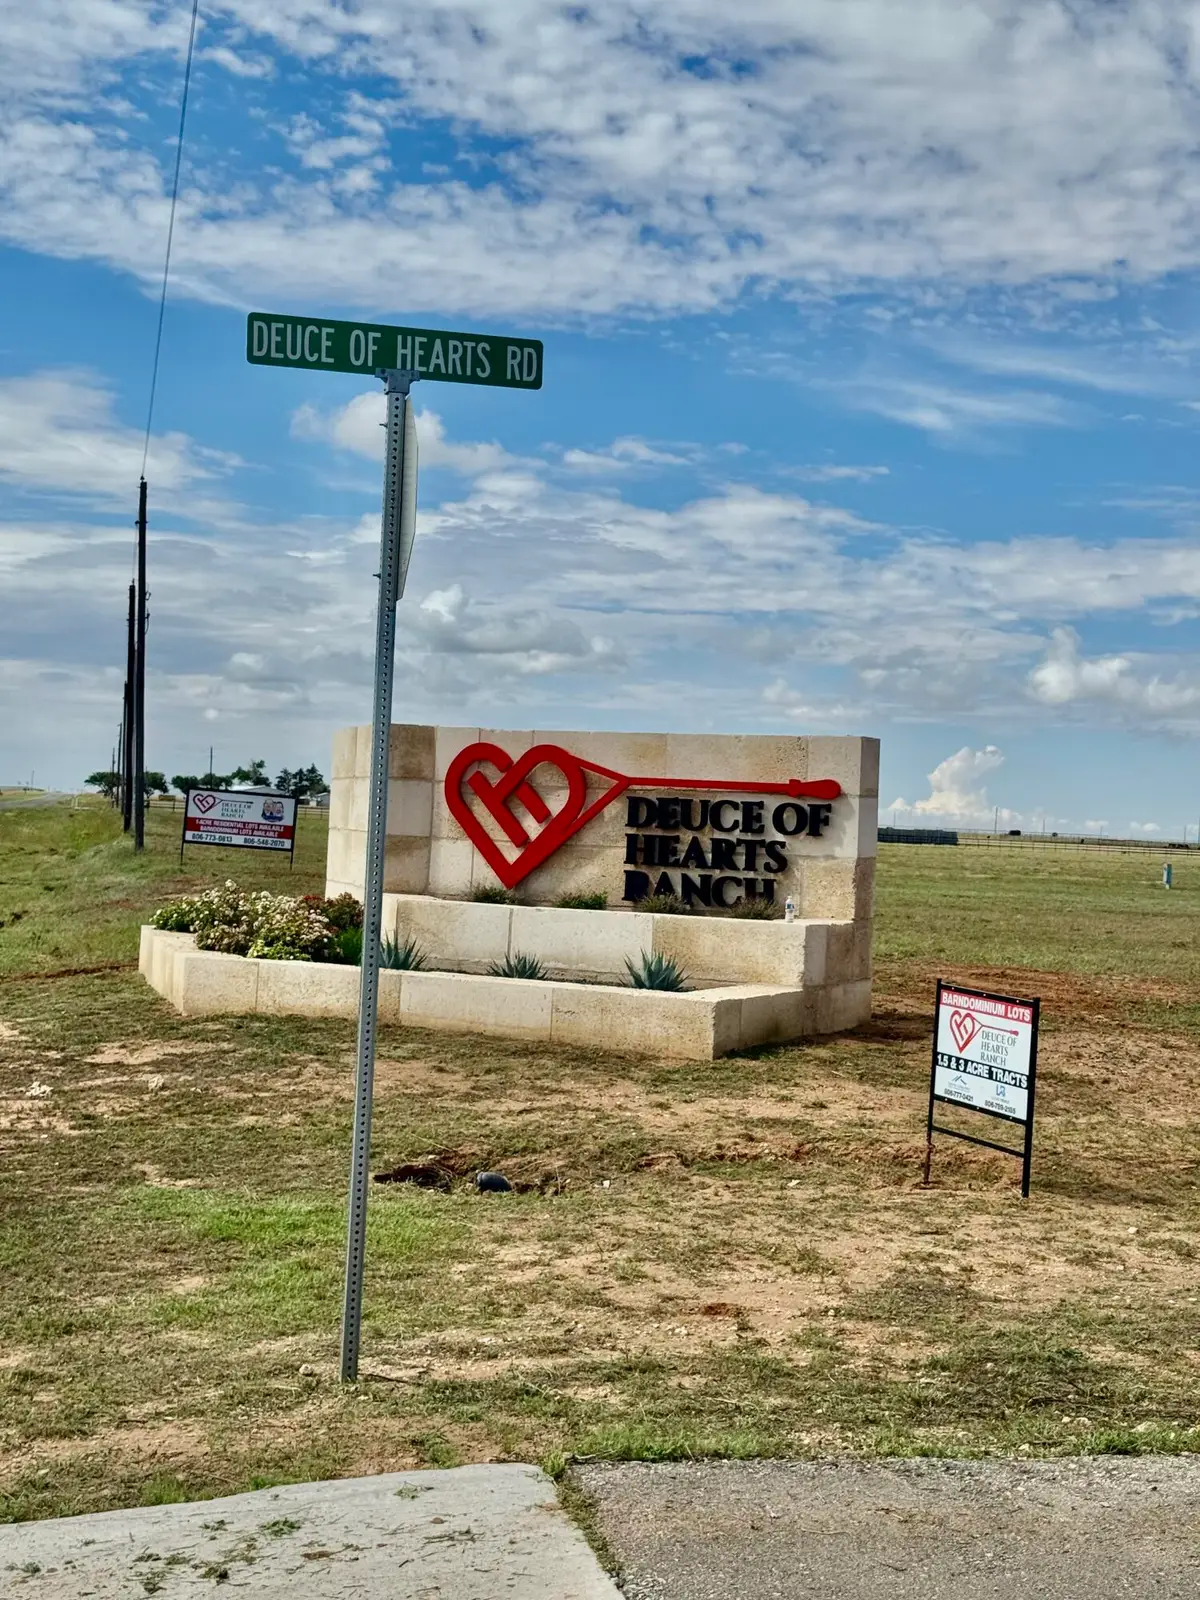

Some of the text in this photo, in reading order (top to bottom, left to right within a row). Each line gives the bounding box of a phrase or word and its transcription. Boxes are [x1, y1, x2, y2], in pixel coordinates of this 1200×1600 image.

[253, 320, 538, 382] DEUCE OF HEARTS RD
[625, 796, 832, 837] DEUCE OF
[623, 833, 789, 873] HEARTS
[942, 992, 1030, 1021] BARNDOMINIUM LOTS
[981, 1041, 1008, 1056] HEARTS
[982, 1030, 1017, 1047] DEUCE OF
[950, 1056, 958, 1069] &
[958, 1059, 964, 1071] 3
[966, 1061, 990, 1078] ACRE
[991, 1068, 1028, 1088] TRACTS
[980, 1052, 1006, 1066] RANCH
